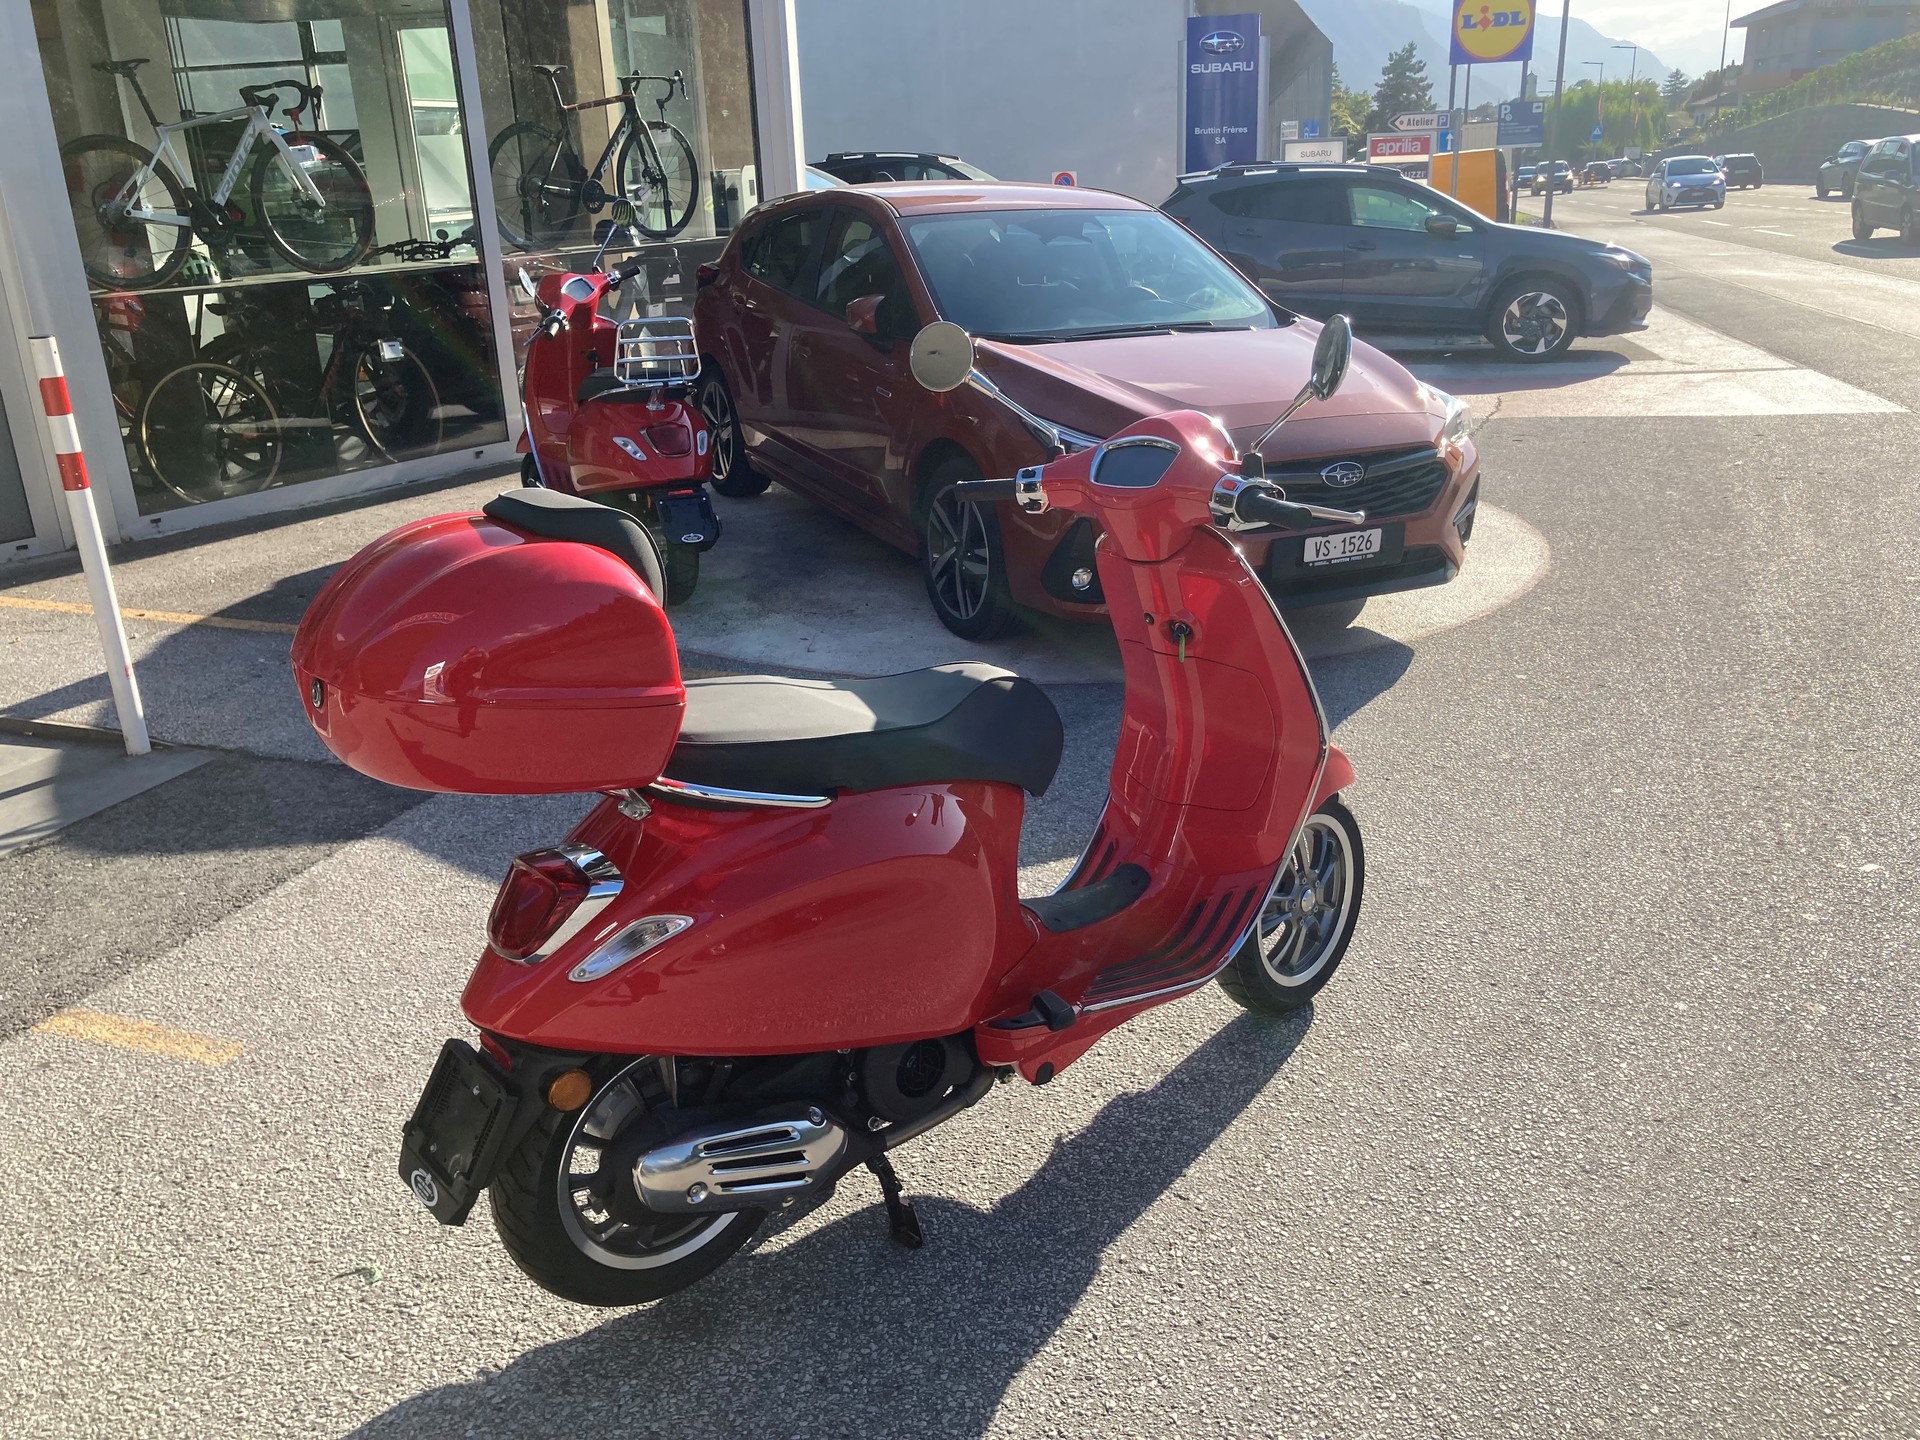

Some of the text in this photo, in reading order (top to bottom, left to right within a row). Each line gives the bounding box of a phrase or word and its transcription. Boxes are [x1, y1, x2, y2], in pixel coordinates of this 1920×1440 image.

[1190, 61, 1254, 74] SUBARU
[1500, 104, 1511, 119] P
[1406, 116, 1447, 127] Atelier P
[1194, 125, 1248, 135] Bruttin Frères
[1214, 136, 1227, 145] SA
[600, 119, 630, 175] RIDLEY
[1376, 139, 1421, 156] aprilia
[1300, 149, 1332, 158] SUBARU
[220, 123, 257, 199] RIDLEY
[1400, 170, 1426, 179] UZZI
